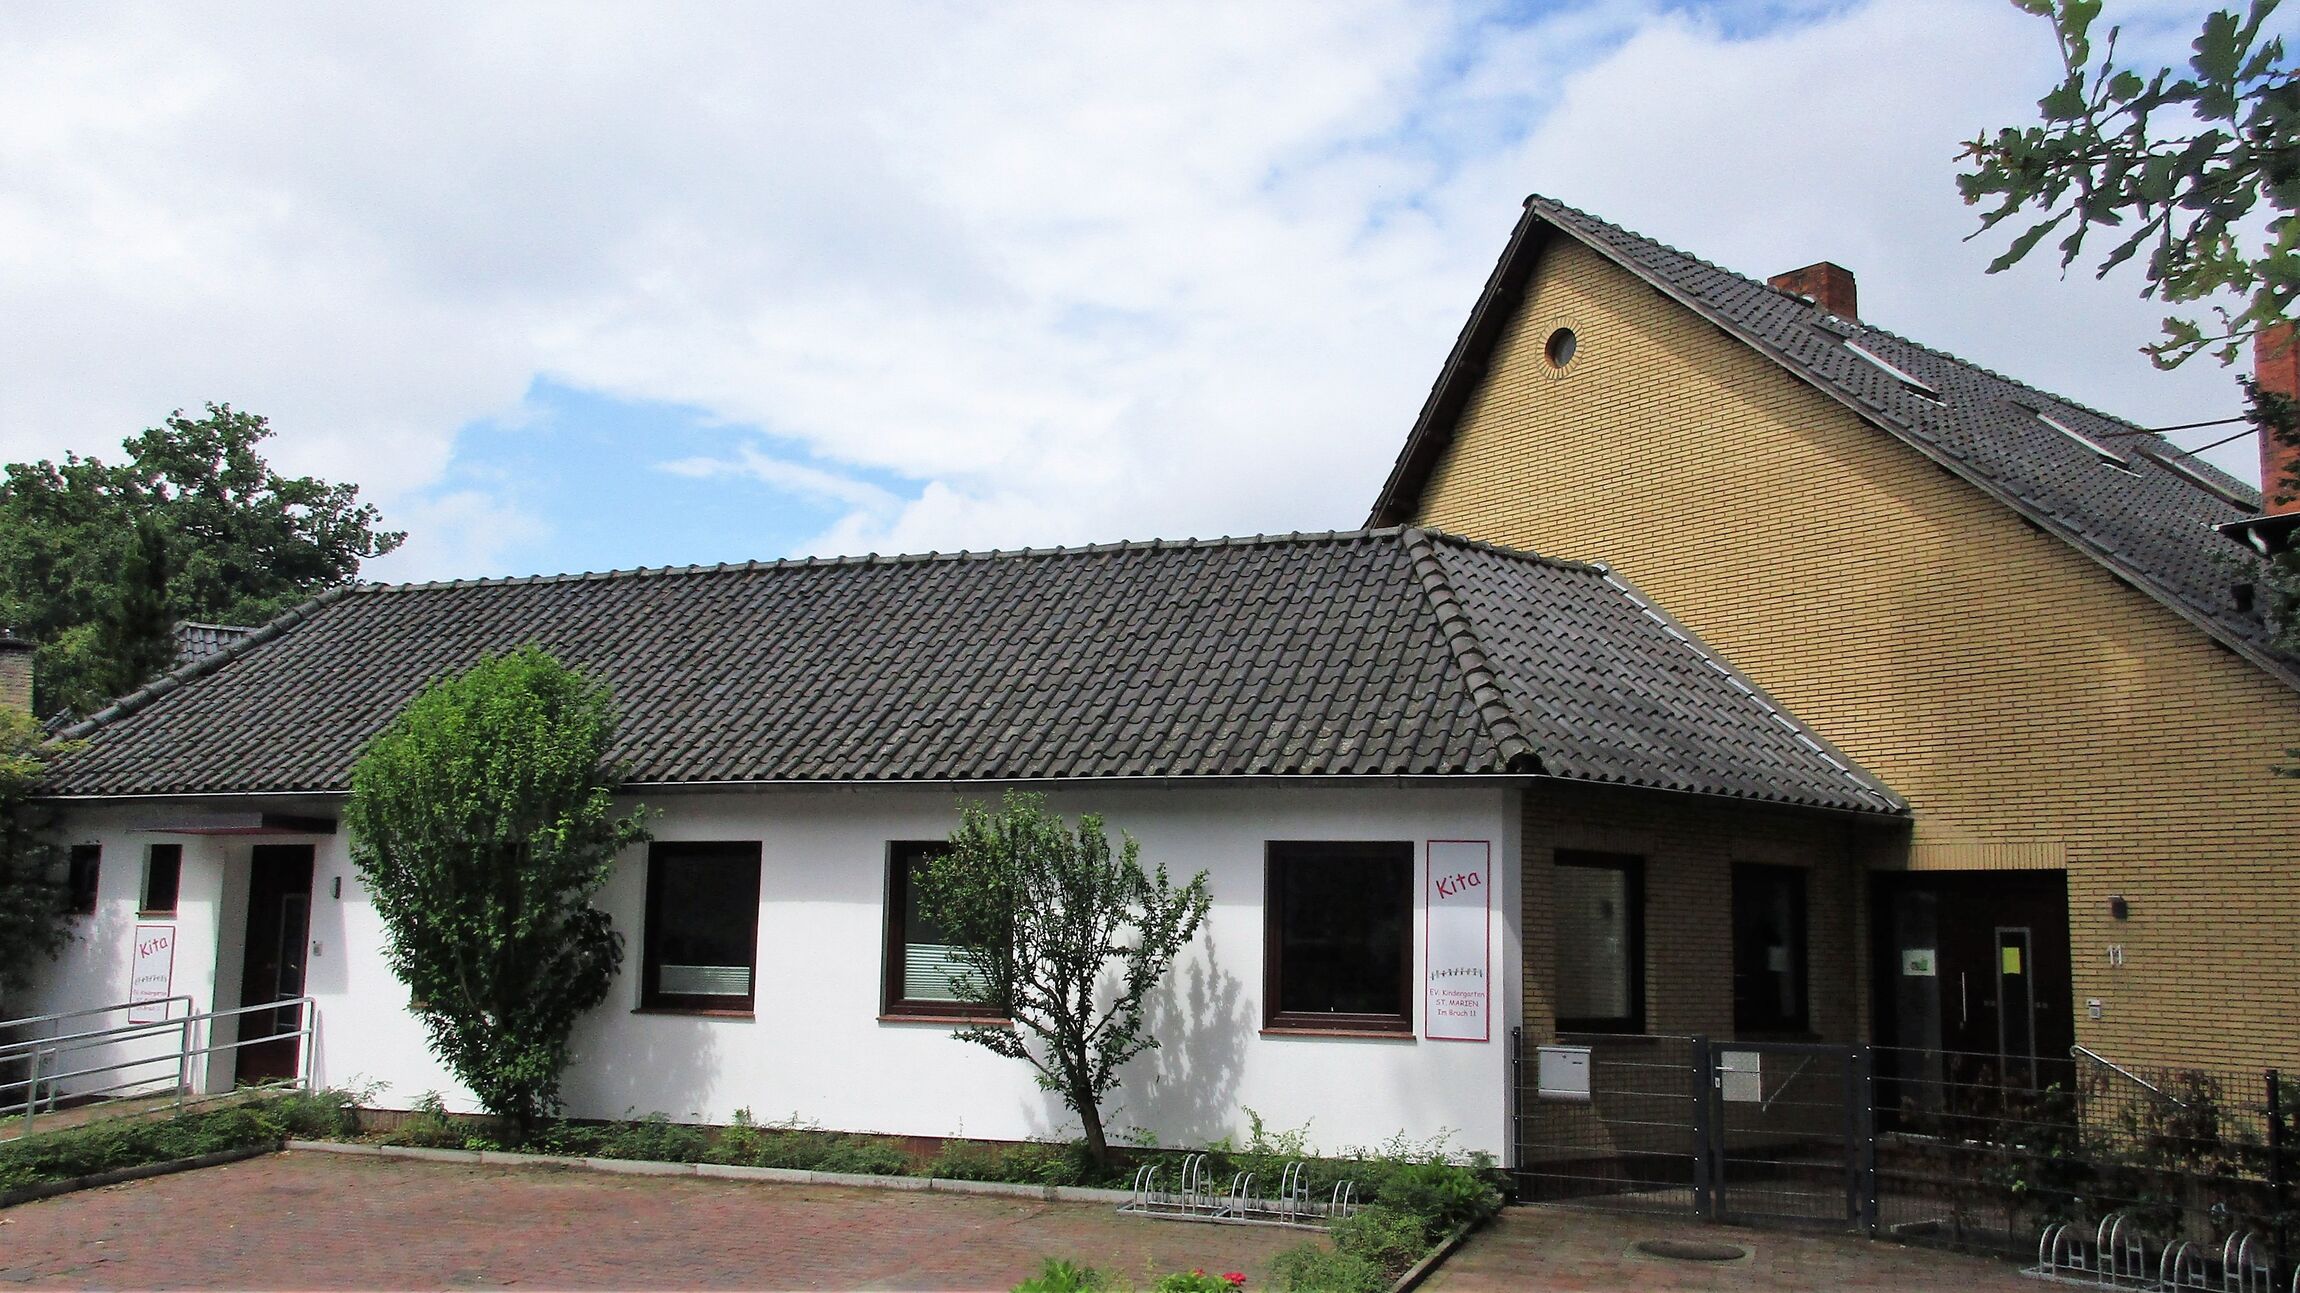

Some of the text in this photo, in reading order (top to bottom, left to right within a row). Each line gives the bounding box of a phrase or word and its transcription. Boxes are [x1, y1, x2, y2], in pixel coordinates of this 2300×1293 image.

[1436, 872, 1481, 899] Kita
[139, 937, 168, 959] Kita
[1443, 990, 1485, 998] Kindergarten
